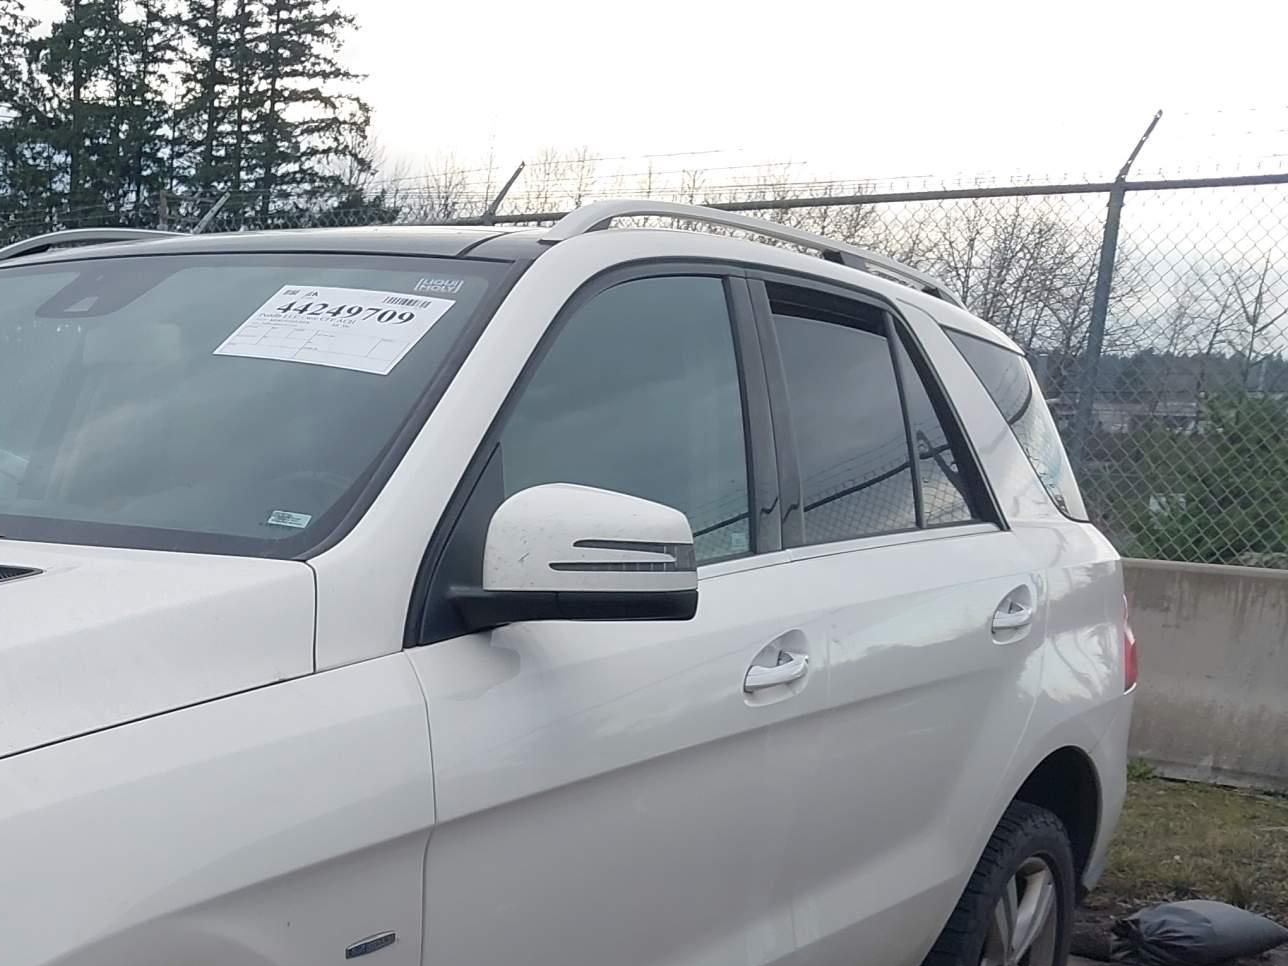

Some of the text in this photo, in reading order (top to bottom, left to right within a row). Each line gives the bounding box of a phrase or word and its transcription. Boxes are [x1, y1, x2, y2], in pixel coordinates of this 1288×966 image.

[422, 279, 459, 287] LIQUI
[418, 284, 456, 292] MOLY
[277, 300, 416, 325] 44249709
